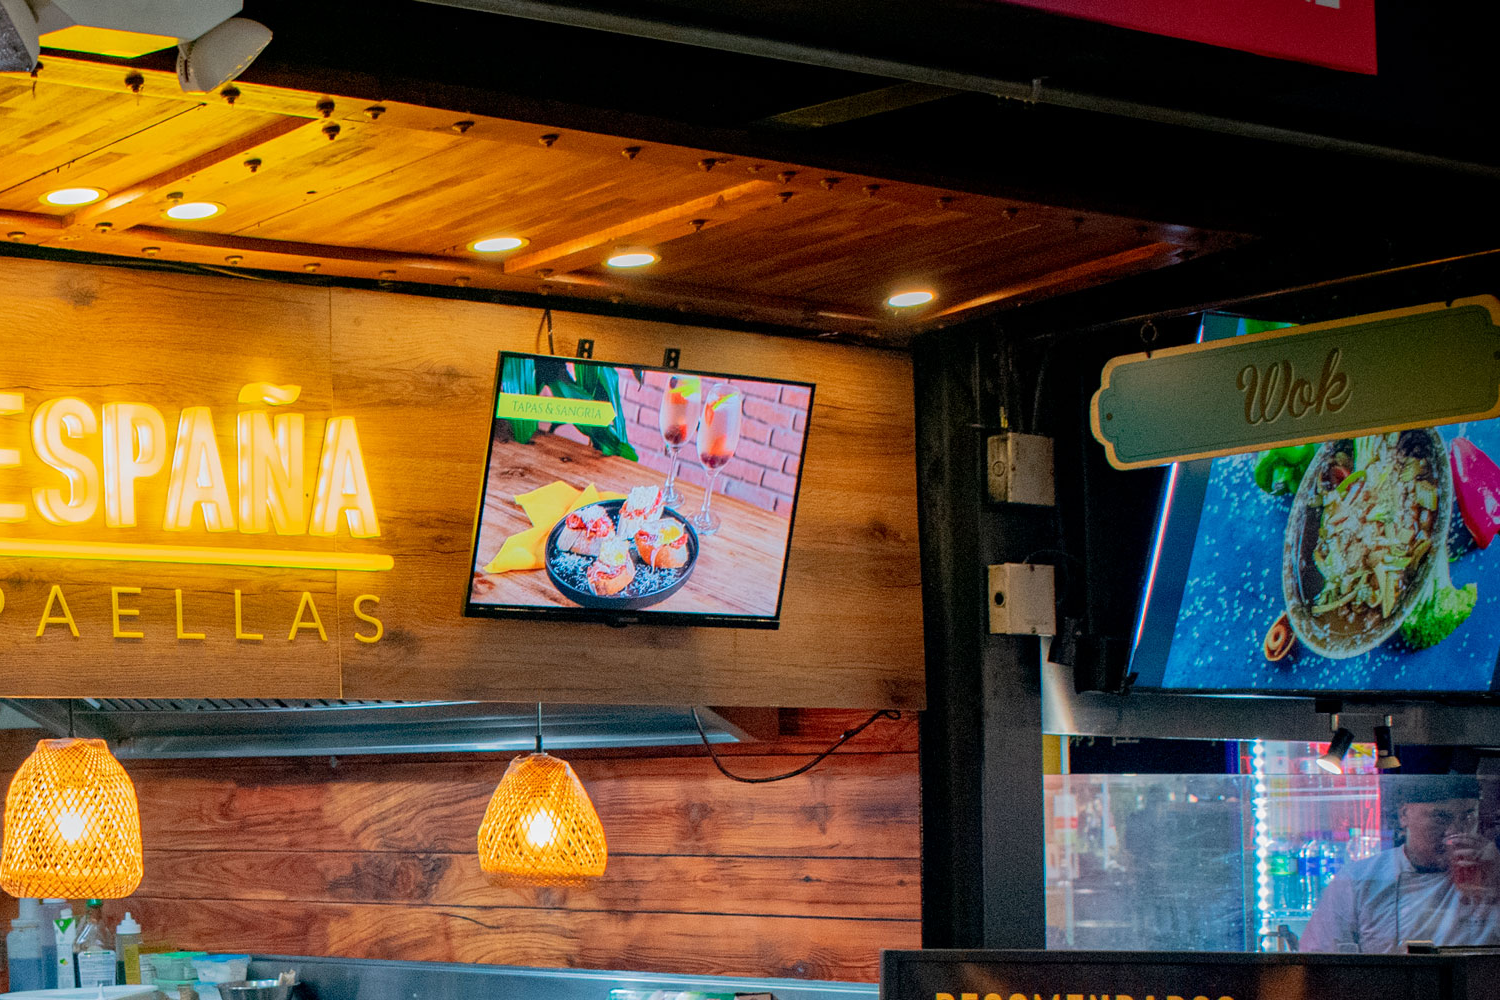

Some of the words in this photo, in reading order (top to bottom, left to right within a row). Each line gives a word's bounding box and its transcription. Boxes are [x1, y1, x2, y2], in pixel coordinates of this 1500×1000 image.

[512, 400, 543, 414] TAPAS
[544, 402, 555, 415] &
[1236, 347, 1353, 427] Wok
